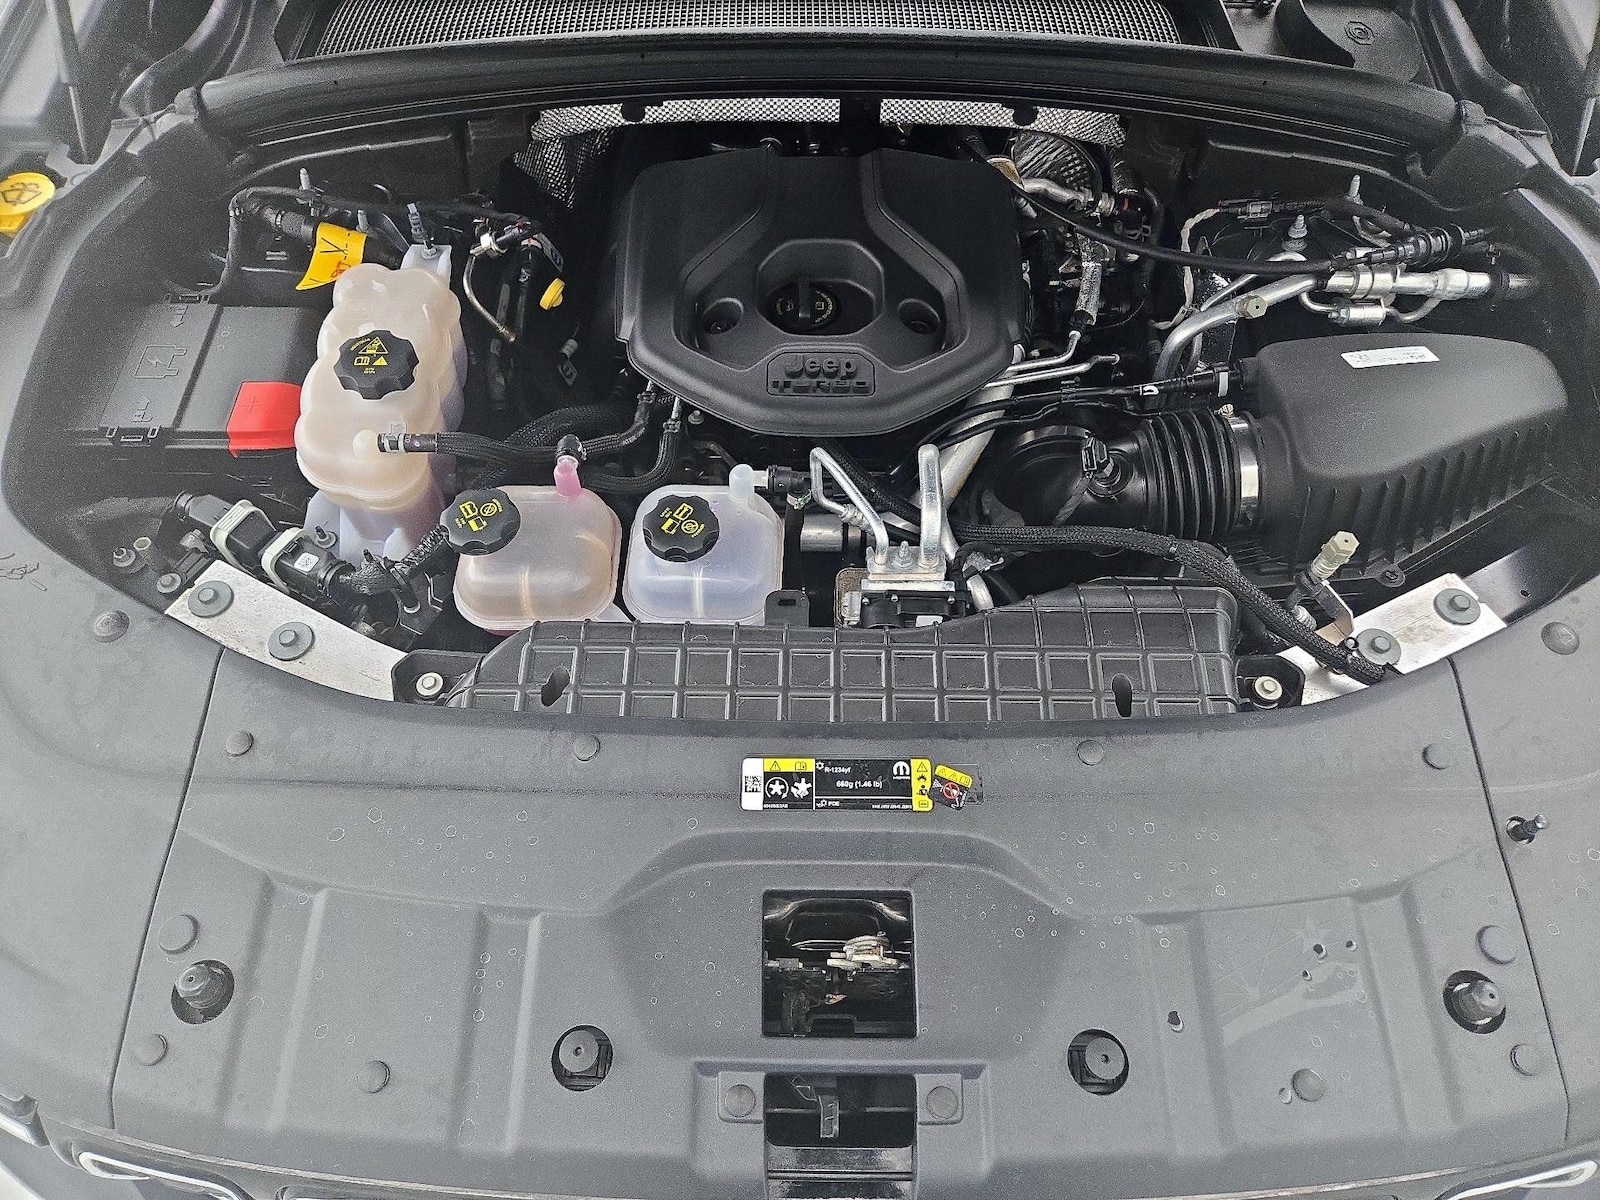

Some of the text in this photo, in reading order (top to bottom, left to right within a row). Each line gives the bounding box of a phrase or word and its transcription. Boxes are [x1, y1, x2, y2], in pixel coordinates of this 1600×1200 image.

[785, 353, 858, 379] Jeep
[771, 380, 871, 393] TURBO
[824, 766, 852, 774] R-1234yf
[836, 780, 854, 789] 660g
[873, 780, 883, 789] lb)
